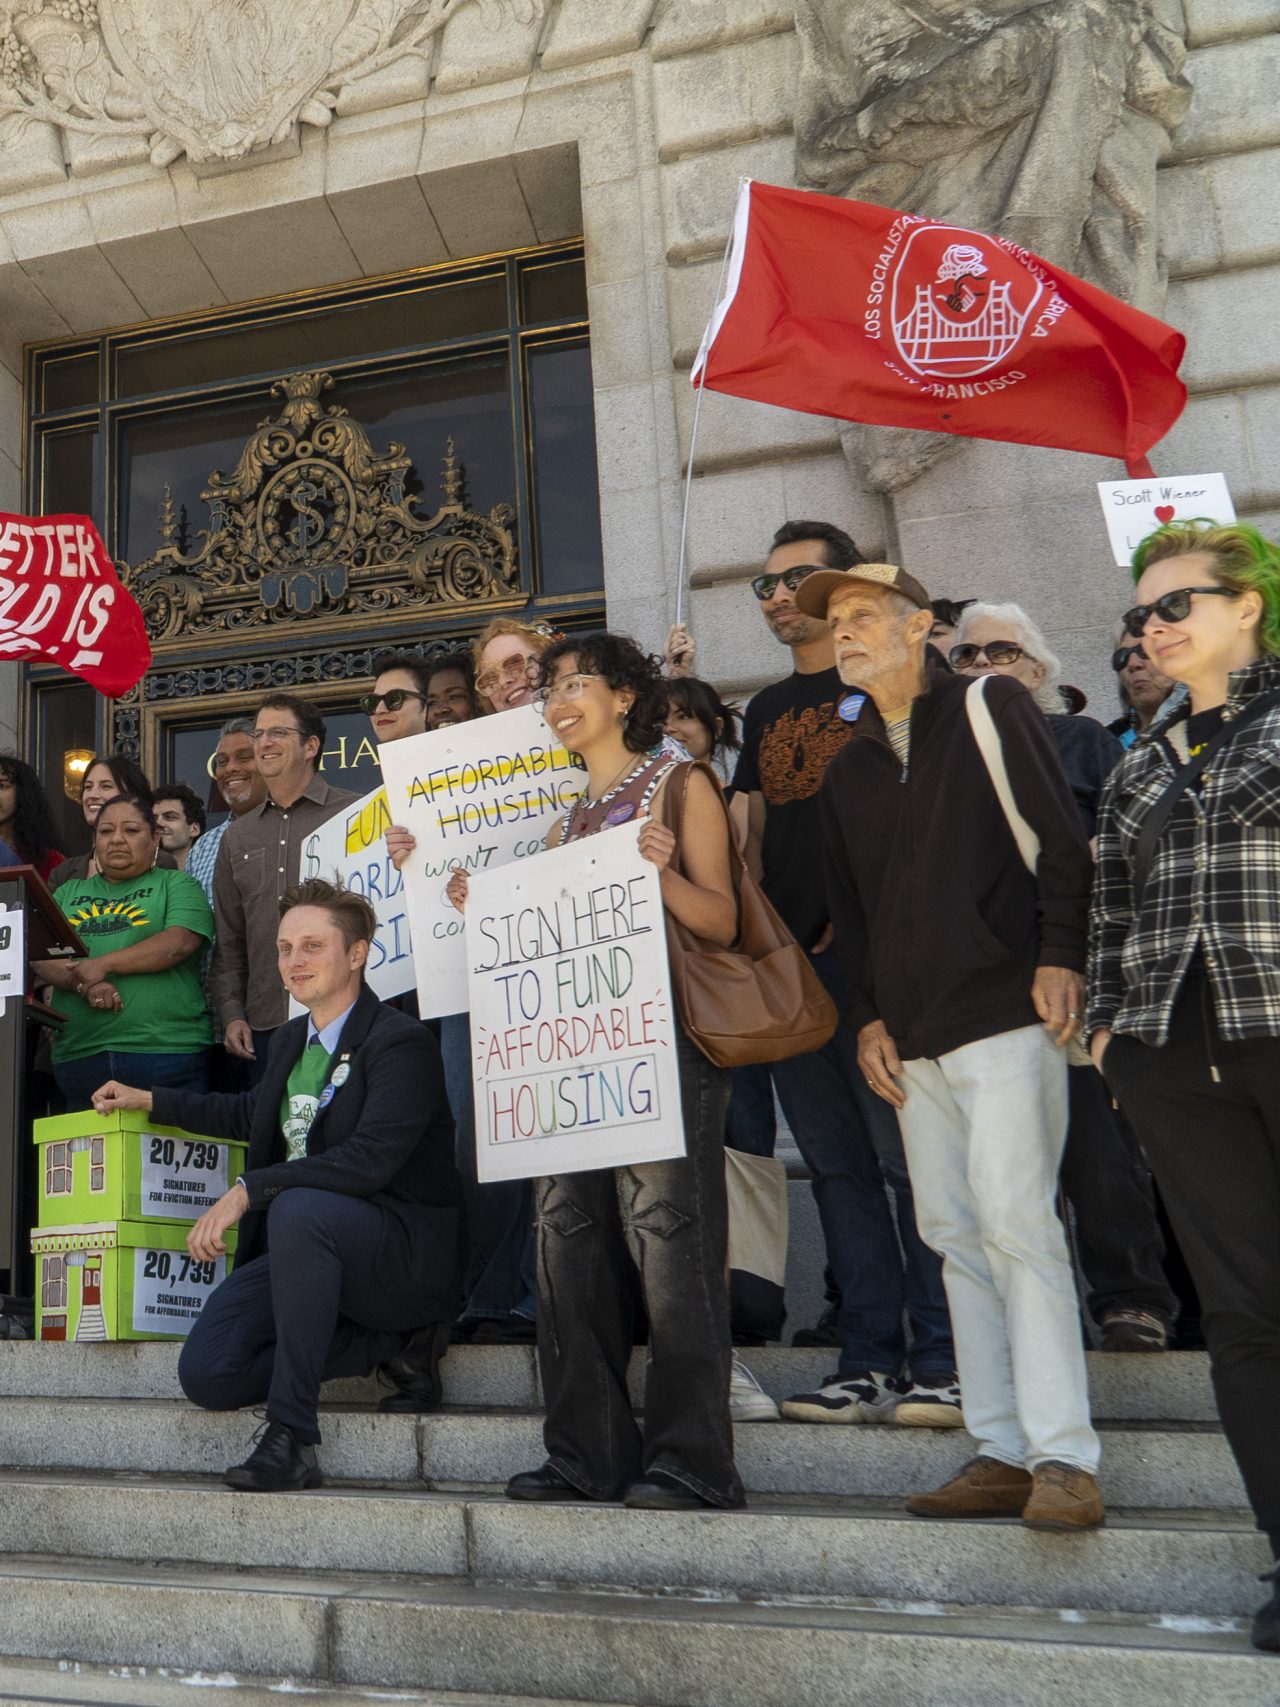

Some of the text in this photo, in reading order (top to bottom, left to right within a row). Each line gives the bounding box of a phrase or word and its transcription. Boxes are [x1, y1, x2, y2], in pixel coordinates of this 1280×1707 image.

[864, 309, 880, 339] LOS
[1112, 487, 1208, 506] Scott Wiener
[61, 583, 115, 648] IS
[438, 780, 579, 838] HOUSING
[345, 798, 393, 858] FUN
[480, 901, 562, 969] SIGN
[573, 875, 651, 946] HERE
[495, 947, 633, 1024] TO FUND
[485, 1001, 656, 1075] AFFORDABLE
[493, 1061, 651, 1141] HOUSING
[150, 1137, 219, 1173] 20,739
[149, 1191, 163, 1201] FOR
[164, 1193, 192, 1205] EVICTION
[163, 1178, 206, 1193] SIGNATURES
[144, 1251, 216, 1288] 20,739
[145, 1305, 156, 1314] FOR
[156, 1293, 202, 1308] SIGNATURES
